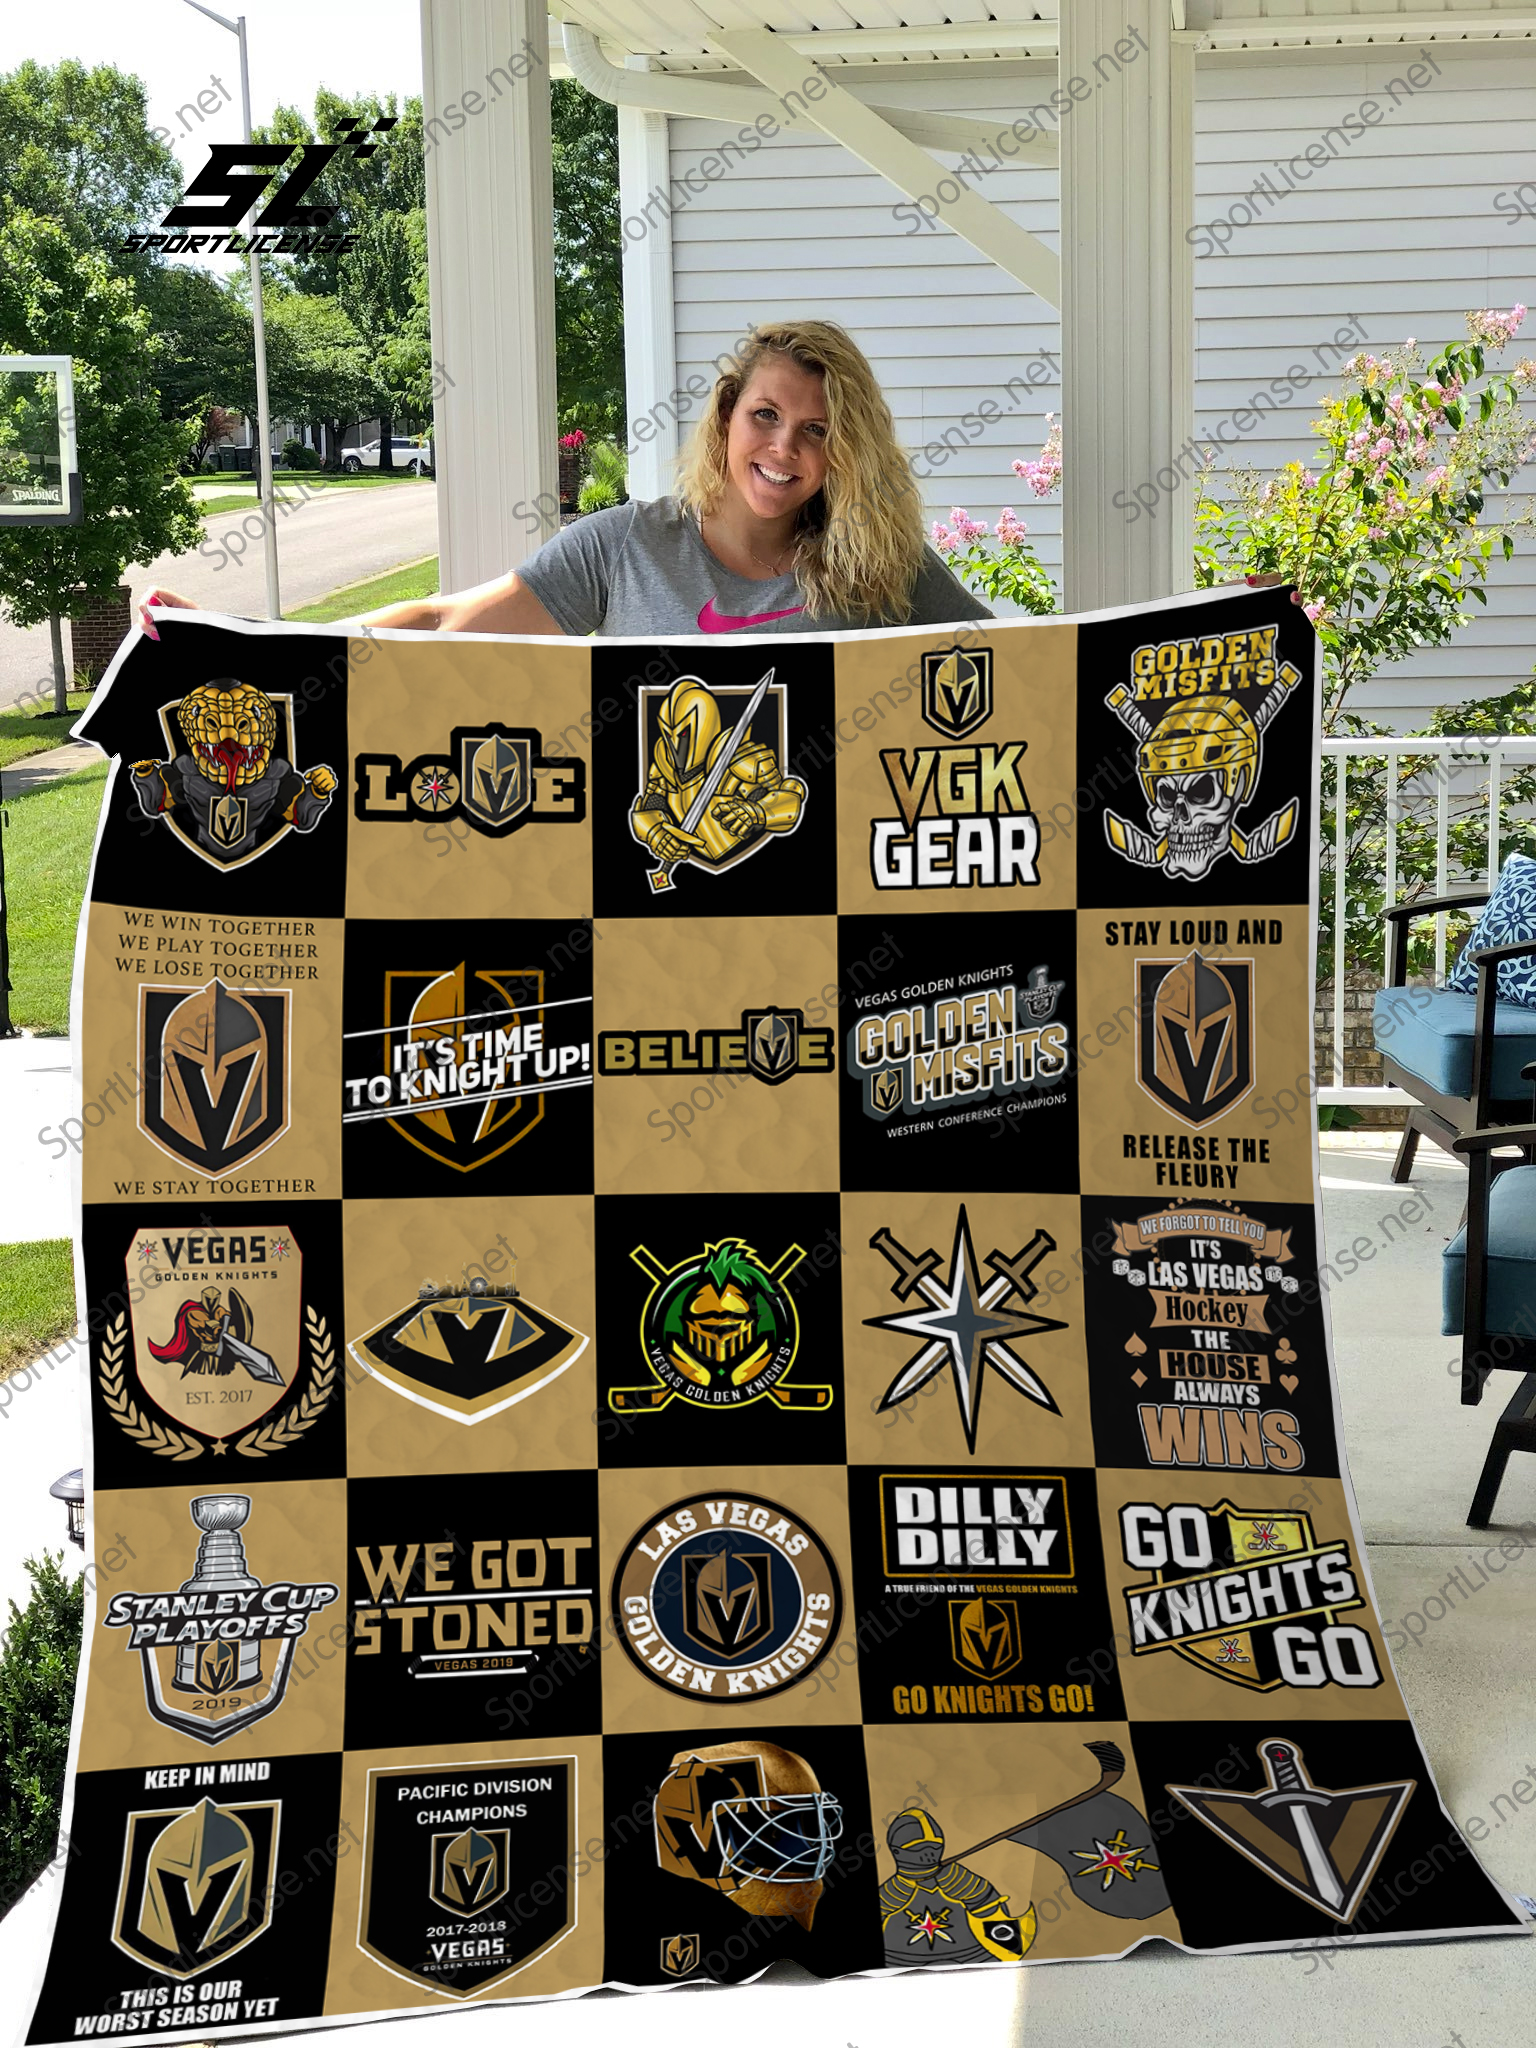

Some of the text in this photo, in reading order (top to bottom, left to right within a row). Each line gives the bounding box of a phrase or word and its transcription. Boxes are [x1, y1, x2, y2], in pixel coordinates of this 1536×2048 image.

[12, 489, 61, 502] SPALDING
[1133, 628, 1276, 677] GOLDEN
[1134, 659, 1275, 701] MISFITS
[879, 741, 1031, 828] VGK
[872, 815, 1039, 888] GEAR
[124, 911, 316, 936] WE WIN TOGETHER
[1105, 919, 1283, 946] STAY LOUD AND
[118, 934, 318, 958] WE PLAY TOGETHER
[115, 957, 319, 980] WE LOSE TOGETHER
[855, 964, 1014, 1009] VEGAS GOLDEN KNIGHTS
[461, 1023, 543, 1061] TIME
[855, 986, 1015, 1069] GOLDEN
[345, 1043, 590, 1107] TO KNIGHT UP!
[911, 1023, 1068, 1105] MISFITS
[887, 1093, 1067, 1138] WESTERN CONFERENCE CHAMPIONS
[1123, 1134, 1270, 1163] RELEASE THE
[114, 1179, 316, 1195] WE STAY TOGETHER
[1156, 1162, 1238, 1189] FLEURY
[1140, 1215, 1264, 1241] WE FORGOT TO TELL YOU
[161, 1236, 266, 1269] VEGAS
[155, 1271, 278, 1281] GOLDEN KNIGHTS
[1148, 1261, 1264, 1292] LAS VEGAS
[1165, 1296, 1249, 1327] Hockey
[1191, 1329, 1231, 1350] THE
[650, 1347, 684, 1388] VEGAS
[1167, 1351, 1262, 1381] HOUSE
[185, 1390, 253, 1405] EST. 2017
[1174, 1380, 1261, 1405] ALWAYS
[1137, 1403, 1305, 1472] WINS
[895, 1487, 1053, 1524] DILLY
[637, 1502, 809, 1561] LAS VEGAS
[897, 1528, 1058, 1566] DILLY
[1122, 1505, 1214, 1568] GO
[355, 1537, 592, 1603] WE GOT
[885, 1585, 1078, 1593] A TRUE FRIEND OF THE VEGAS GOLDEN KNIGHTS
[1129, 1552, 1357, 1646] KNIGHTS
[132, 1613, 305, 1645] PLAYOFFS
[354, 1599, 593, 1655] STONED
[624, 1593, 831, 1695] GOLDEN KNIGHTS
[1272, 1625, 1381, 1687] GO
[434, 1657, 514, 1671] VEGAS 2019
[191, 1697, 242, 1711] 2019
[892, 1683, 1095, 1714] GO KNIGHTS GO!
[144, 1762, 271, 1789] KEEP IN MIND
[397, 1777, 553, 1801] PACIFIC DIVISION
[416, 1804, 528, 1825] CHAMPIONS
[426, 1920, 507, 1937] 2017-2018
[423, 1957, 513, 1972] GOLDEN KNIGHTS
[431, 1938, 504, 1963] VEGAS
[120, 1980, 243, 2009] THIS IS OUR
[74, 1997, 280, 2036] WORST SEASON YET
